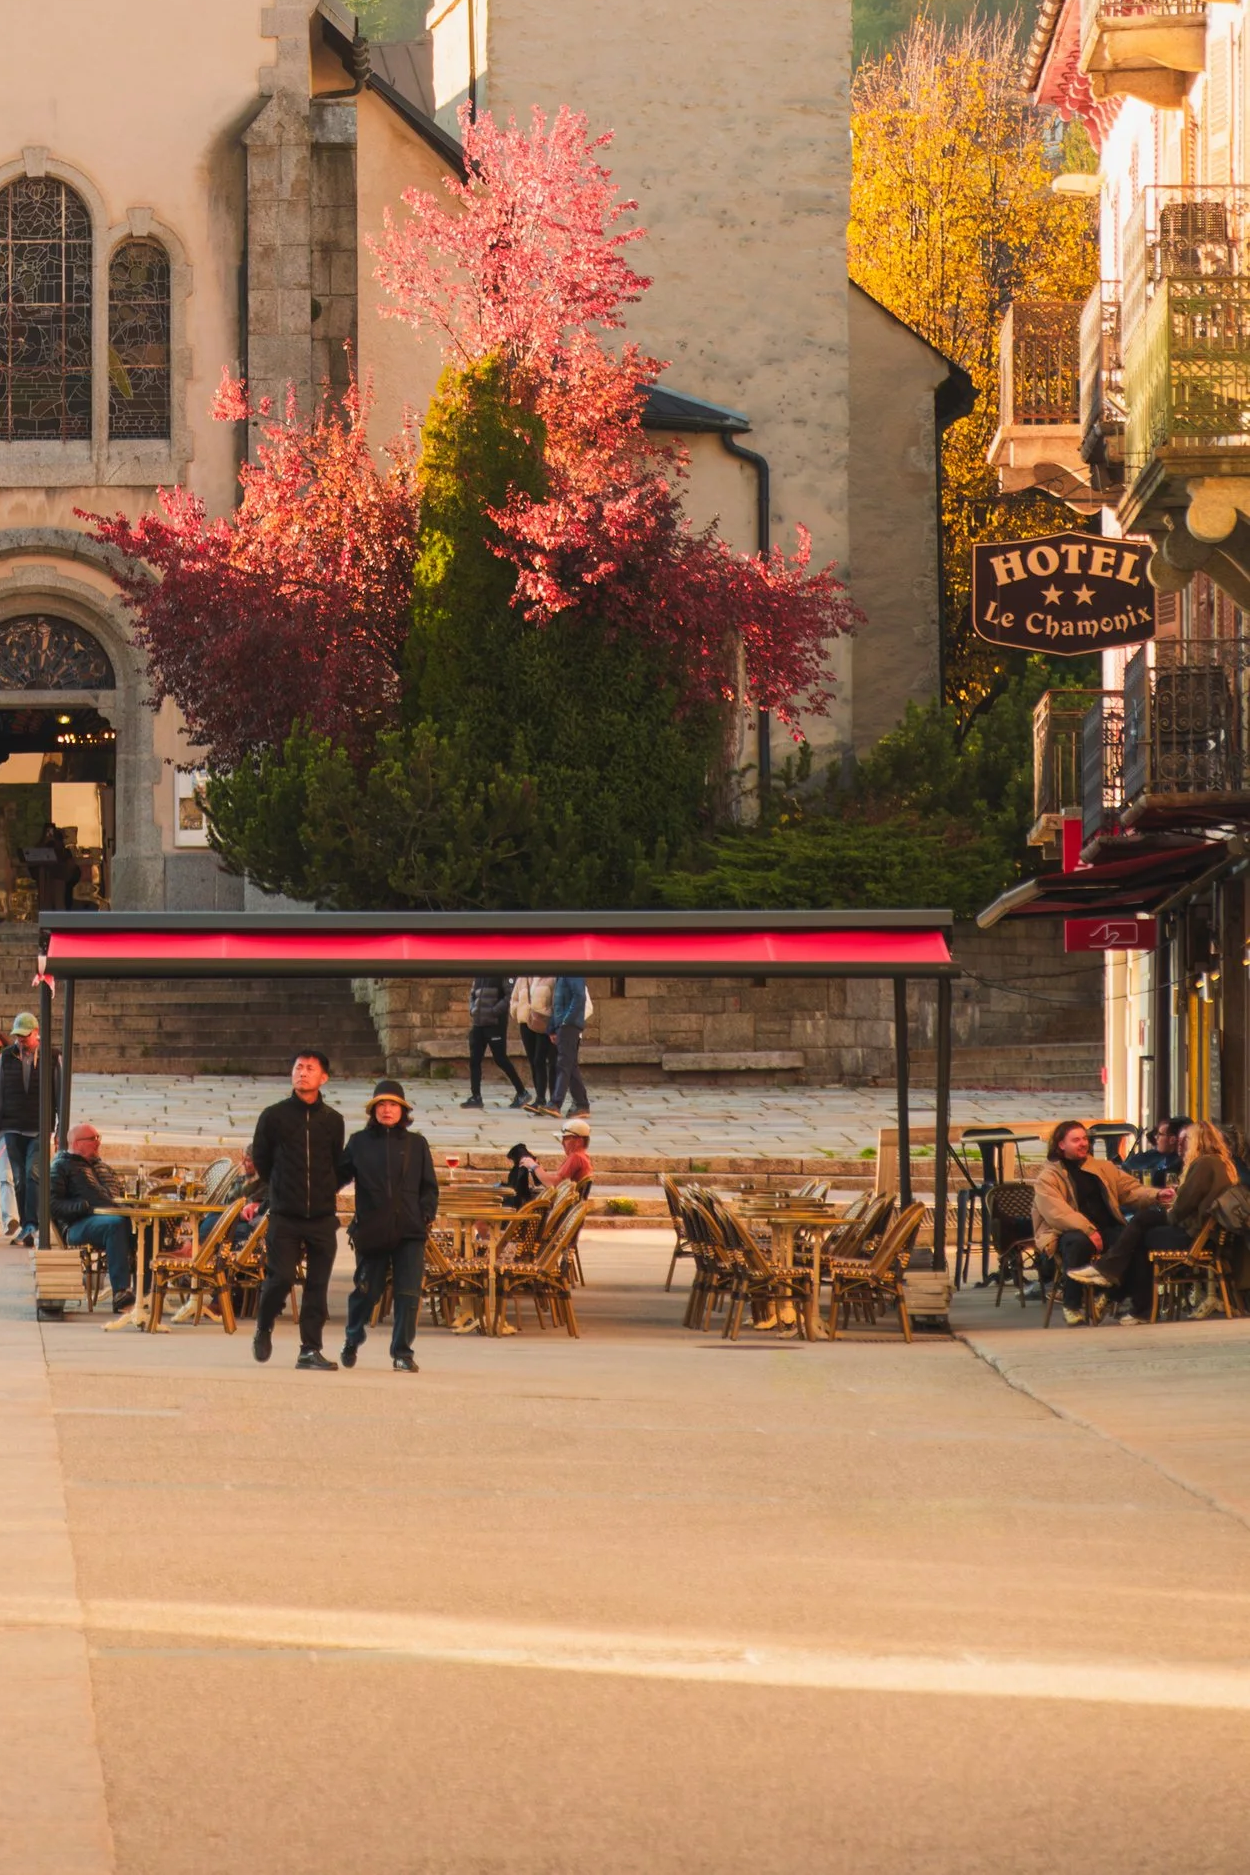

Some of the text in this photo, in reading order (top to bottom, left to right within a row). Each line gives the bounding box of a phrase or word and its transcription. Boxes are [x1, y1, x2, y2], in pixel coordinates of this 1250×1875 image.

[989, 544, 1141, 587] HOTEL
[983, 600, 1153, 640] Le Chamonix
